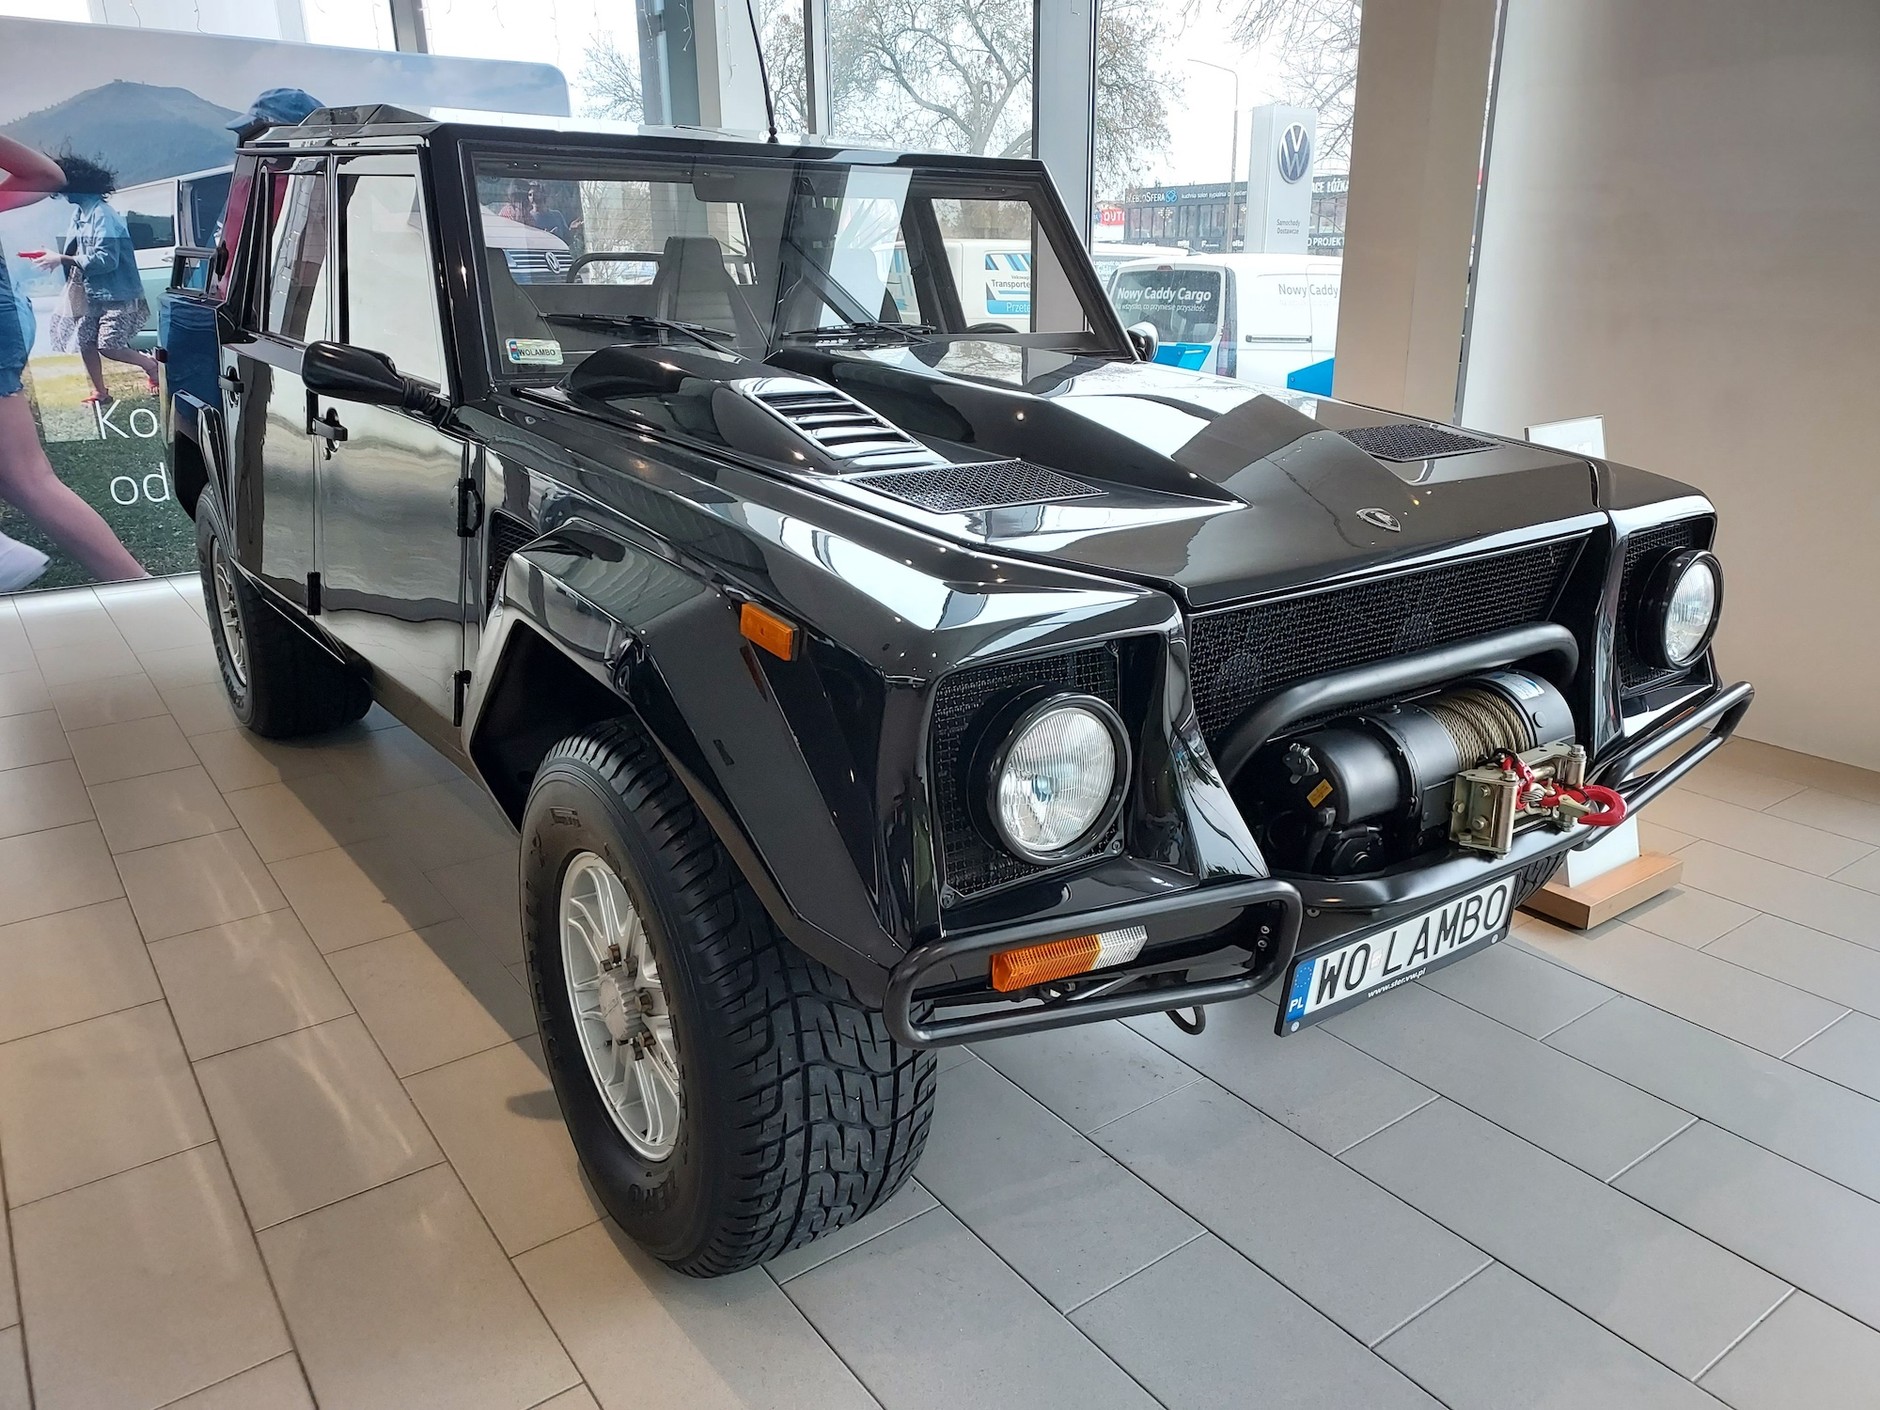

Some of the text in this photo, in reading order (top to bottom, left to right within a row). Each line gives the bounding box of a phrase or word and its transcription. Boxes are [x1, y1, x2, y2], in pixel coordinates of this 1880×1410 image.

[1118, 287, 1212, 304] Nowy Caddy Cargo
[1278, 283, 1338, 299] Nowy Caddy
[95, 399, 158, 440] Ko
[110, 462, 171, 505] od
[1316, 884, 1508, 1005] WO LAMBO
[1289, 998, 1303, 1012] PL
